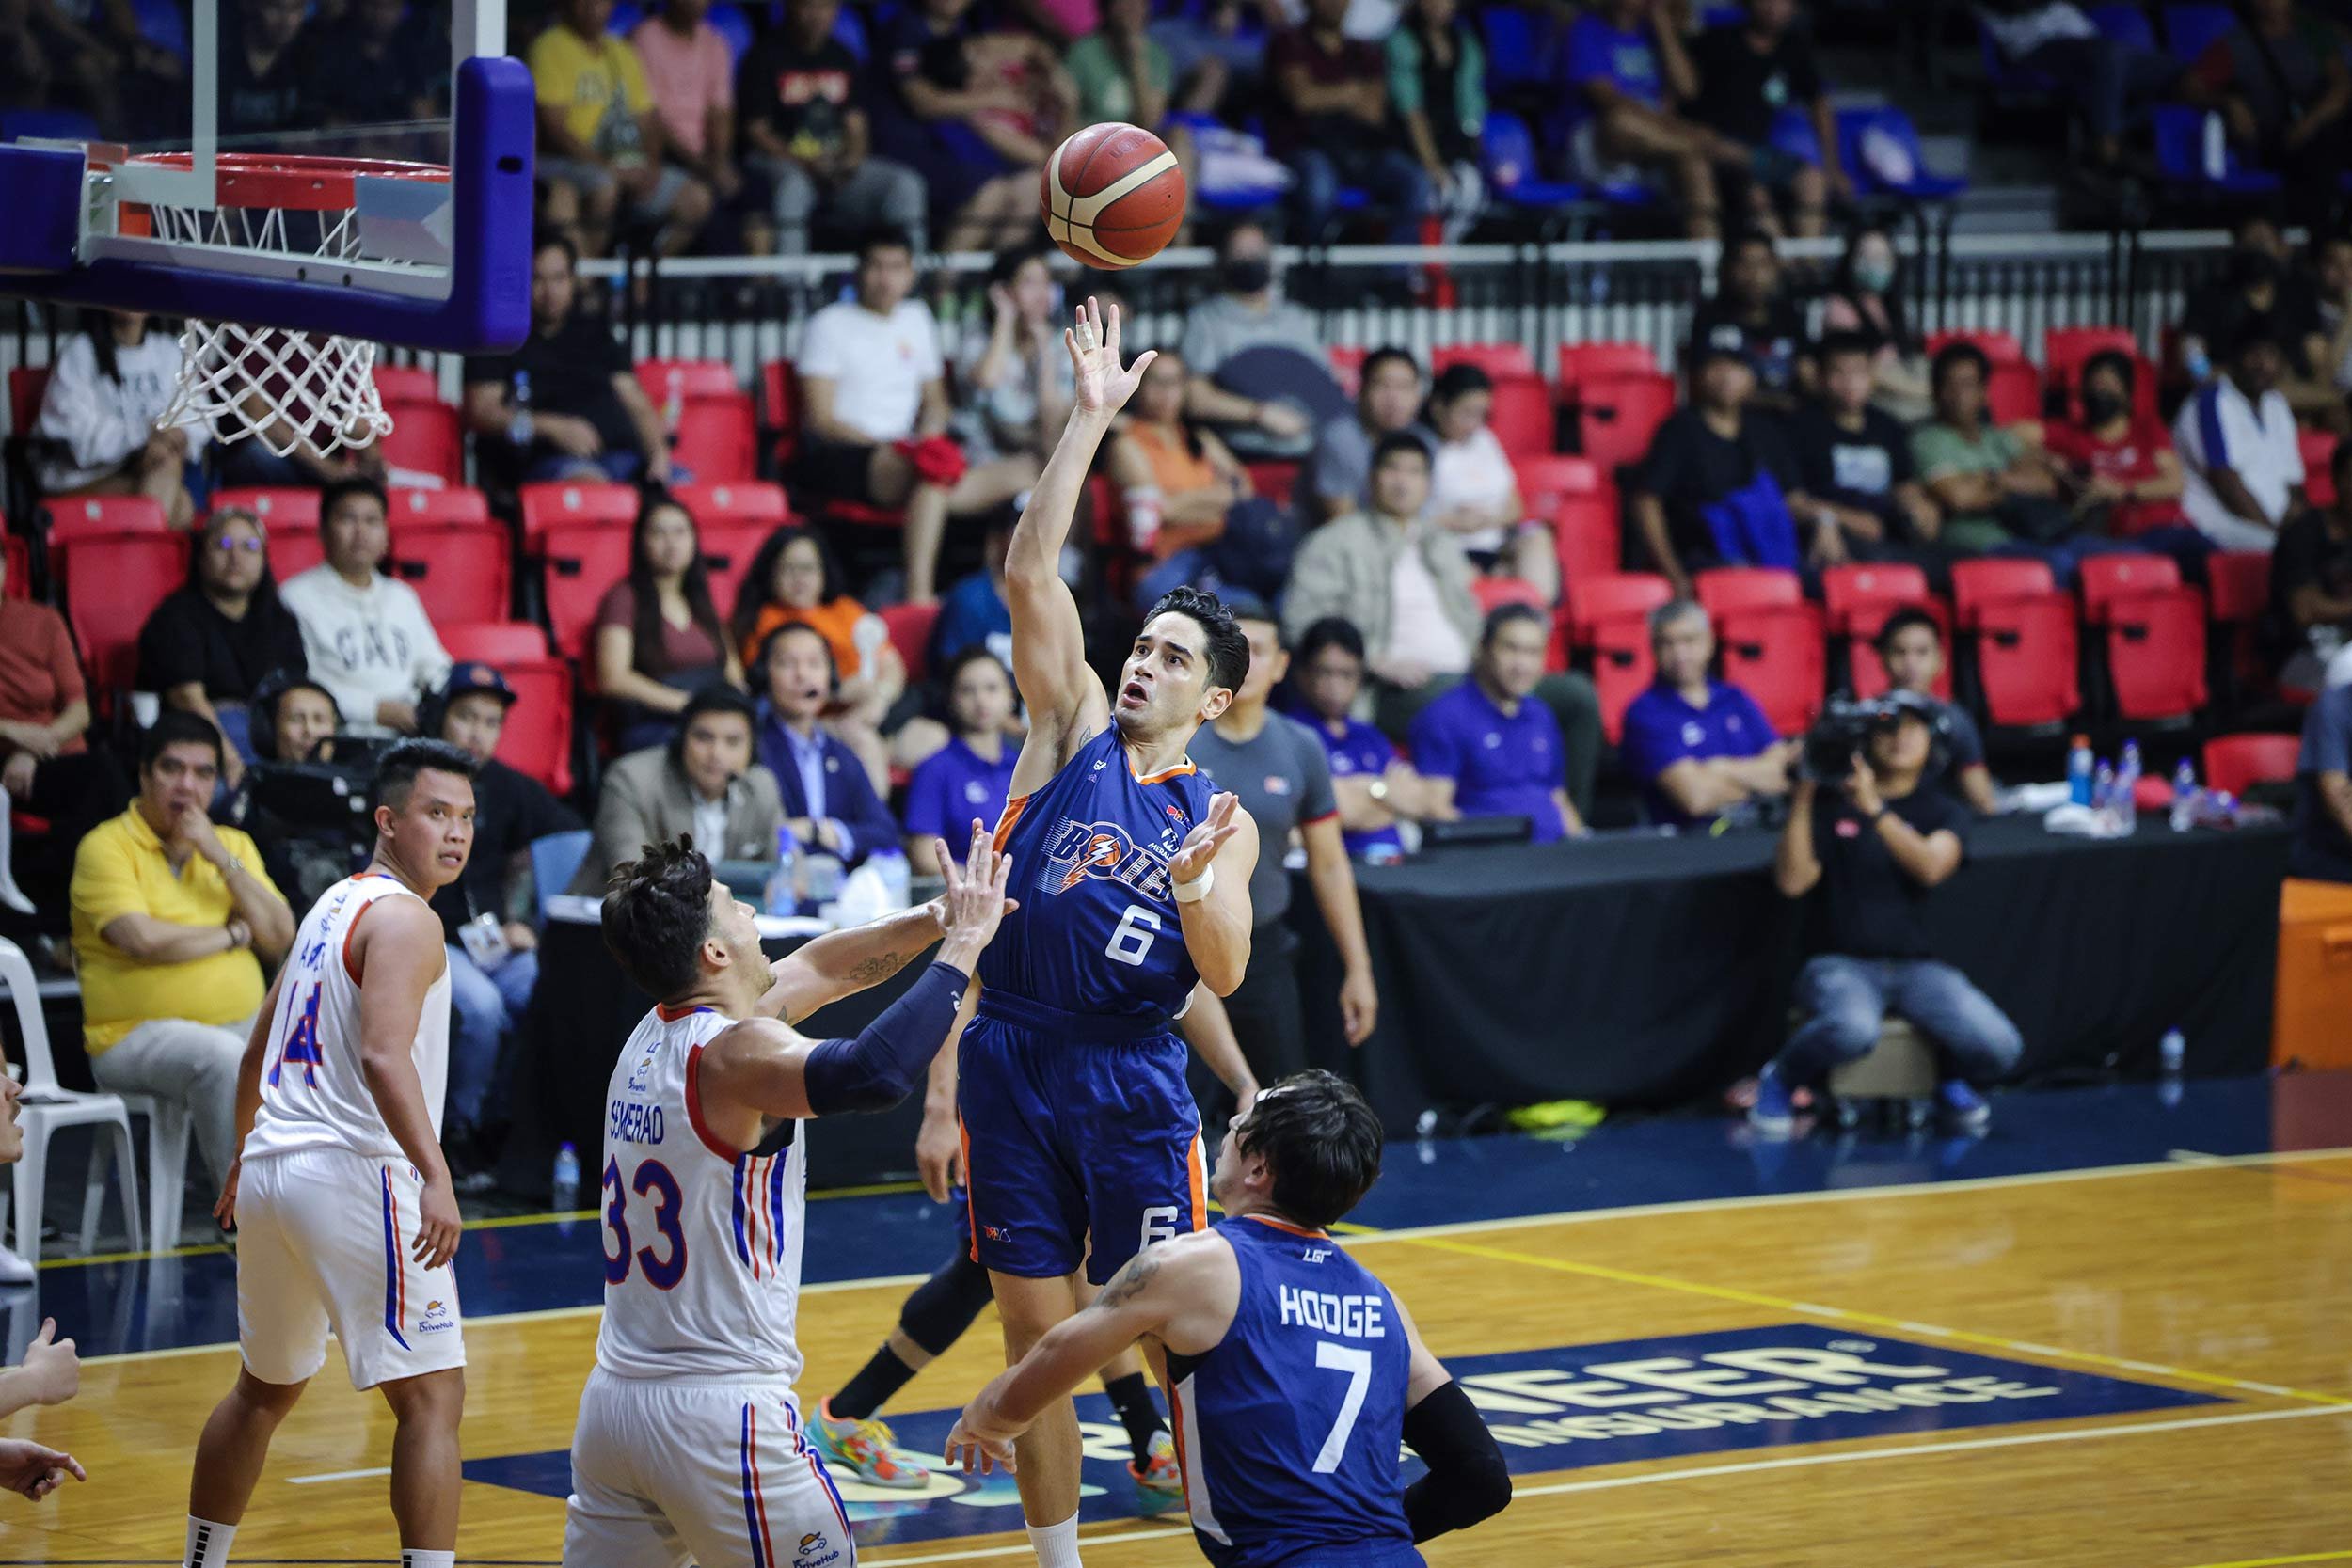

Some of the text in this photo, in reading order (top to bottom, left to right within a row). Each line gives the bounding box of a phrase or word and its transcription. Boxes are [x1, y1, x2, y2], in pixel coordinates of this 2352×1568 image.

[336, 624, 411, 672] GAP
[1147, 842, 1173, 862] MERAL
[1105, 905, 1161, 966] 6
[268, 980, 323, 1090] 14
[602, 1153, 688, 1291] 33
[1279, 1283, 1386, 1338] HODGE
[1311, 1340, 1372, 1474] 7
